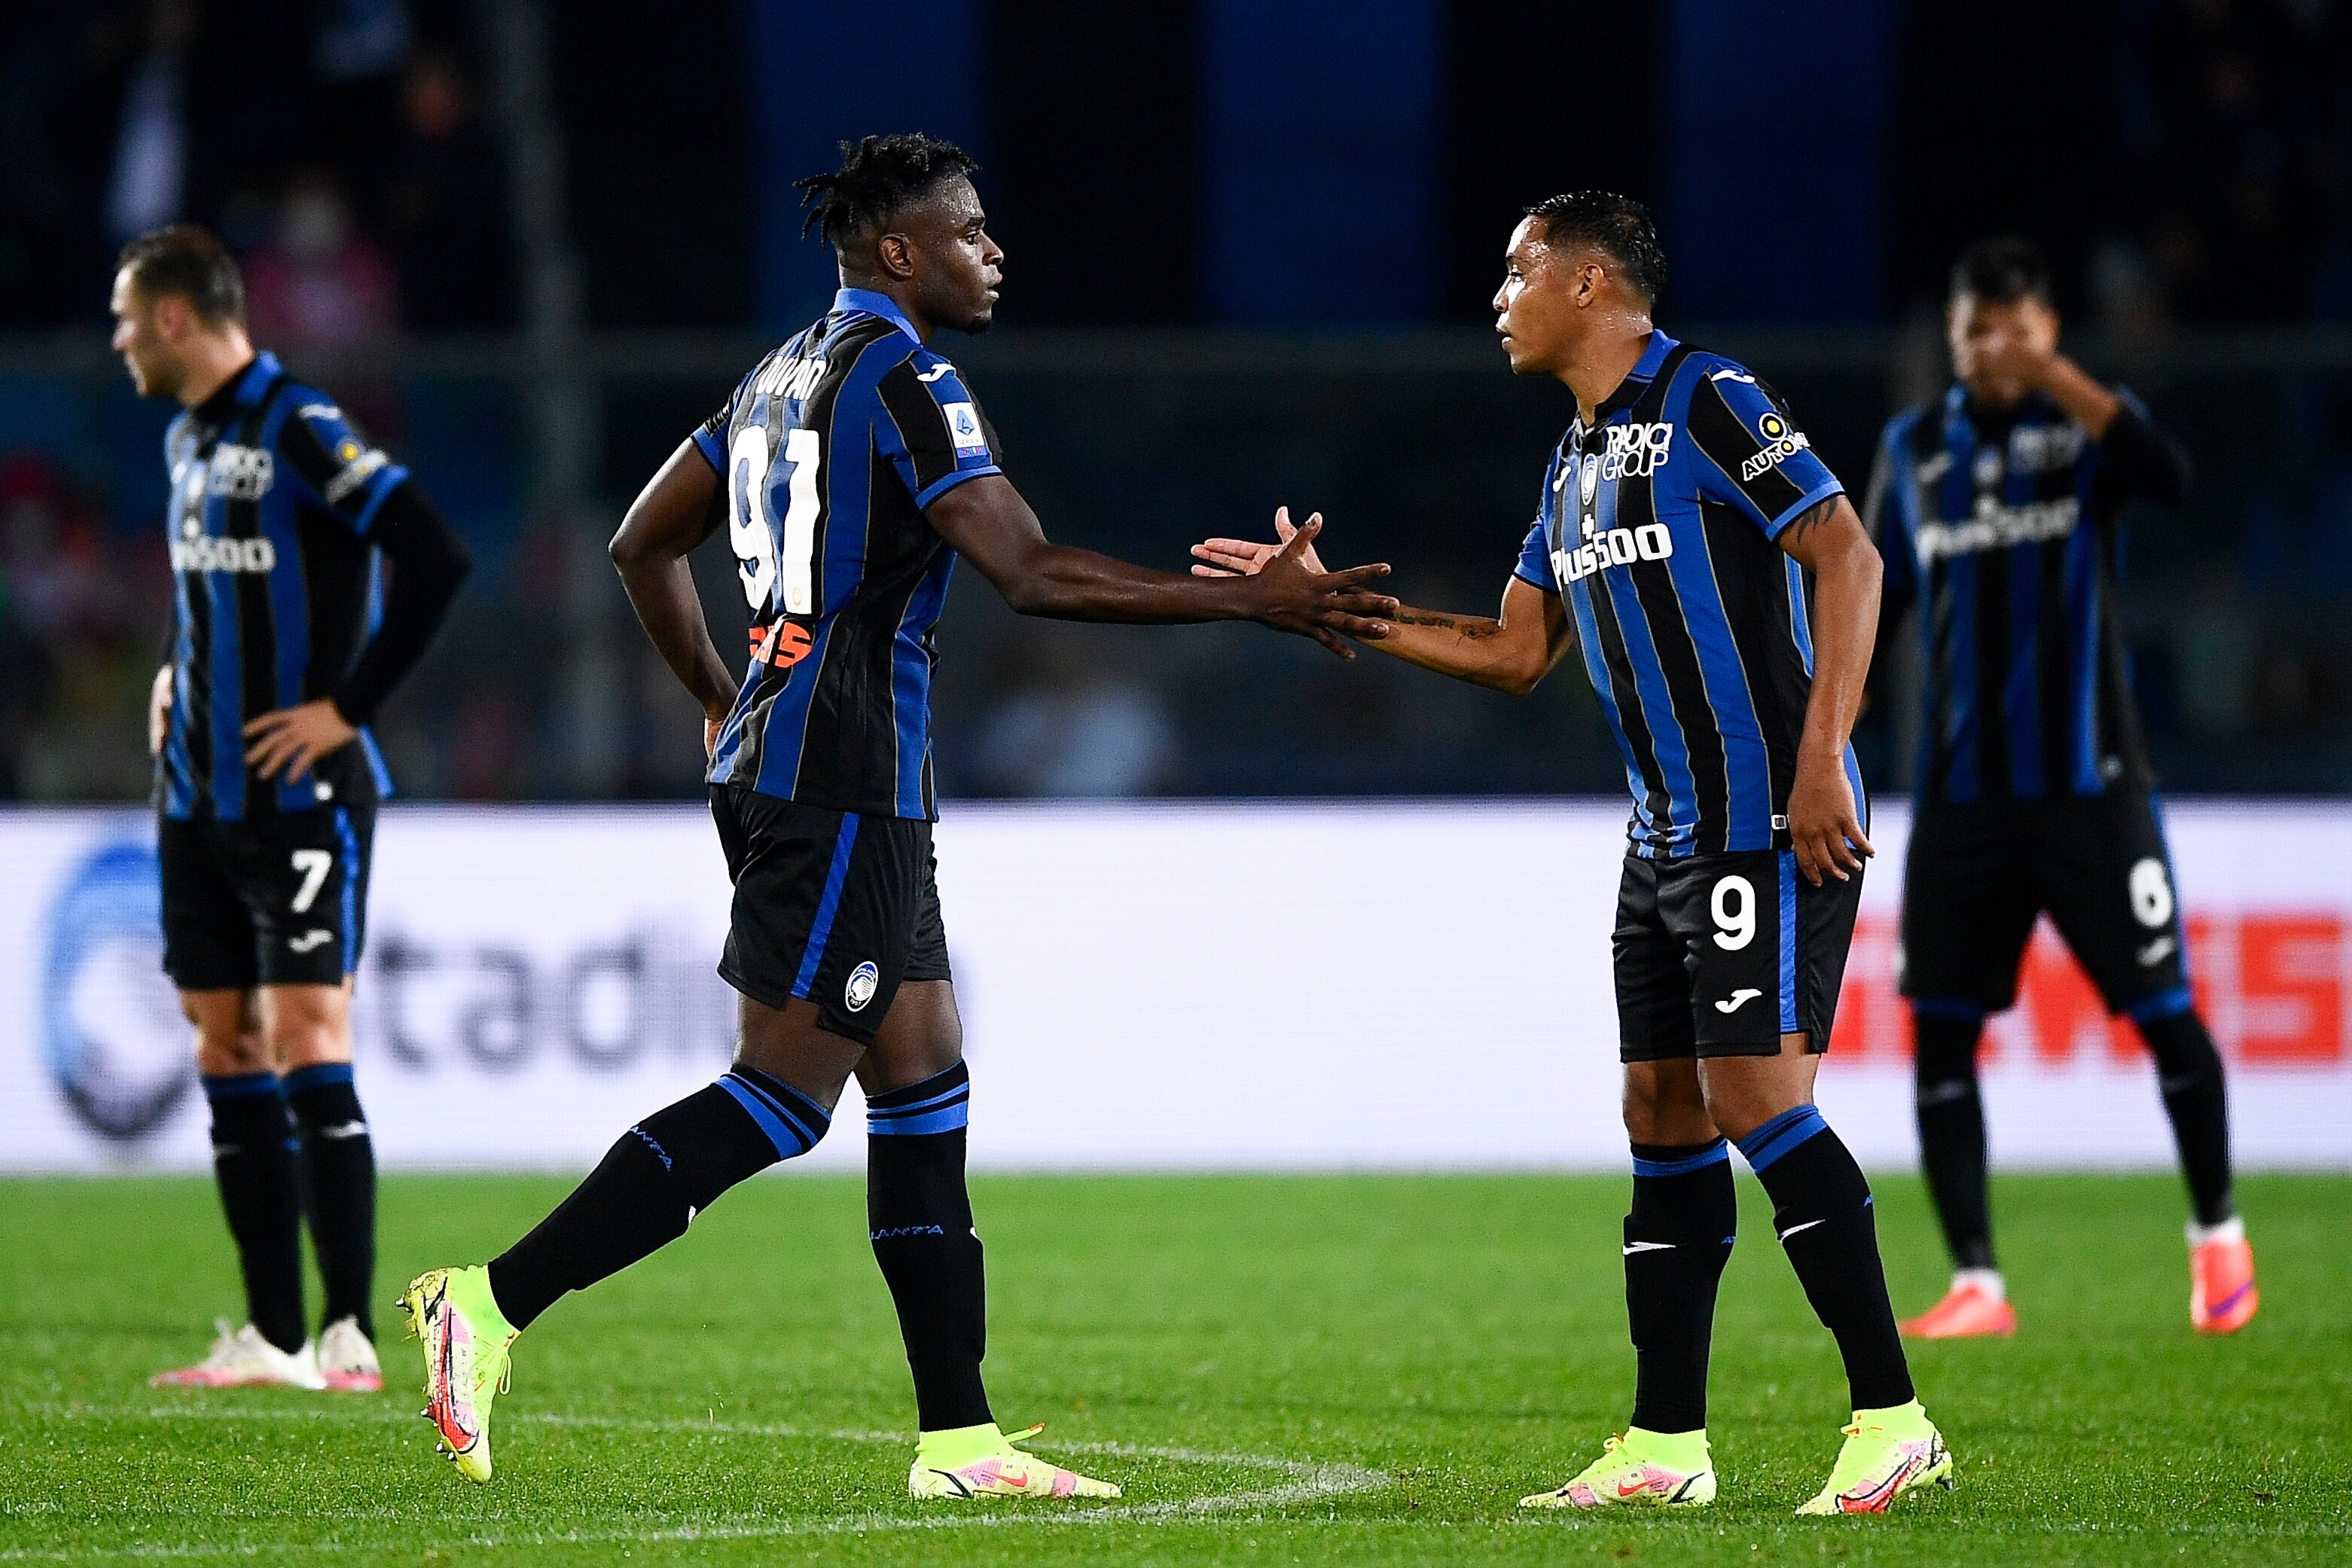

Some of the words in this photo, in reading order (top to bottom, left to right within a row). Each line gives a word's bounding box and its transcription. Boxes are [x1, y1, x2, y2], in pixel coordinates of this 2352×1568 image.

[1602, 450, 1669, 481] GROUP
[1605, 423, 1673, 454] RADICI
[728, 424, 820, 615] 91
[1550, 523, 1673, 592] Plus500
[291, 849, 333, 914] 7
[1710, 874, 1756, 951] 9
[2128, 856, 2174, 929] 6
